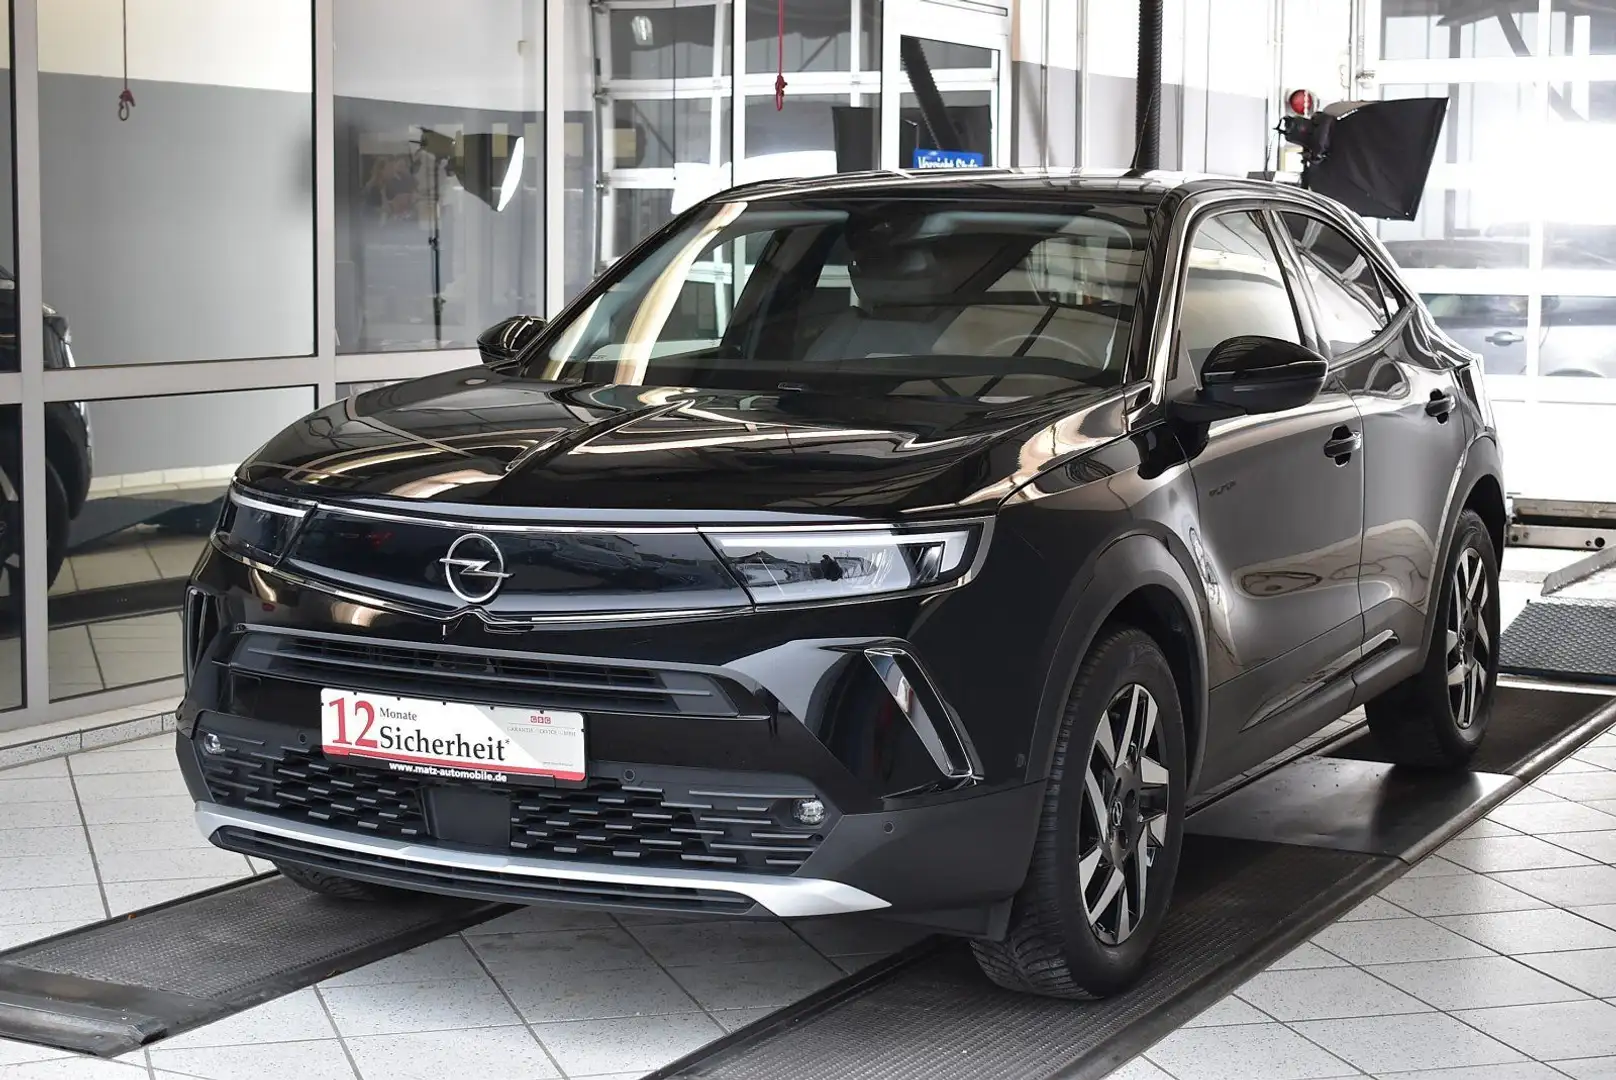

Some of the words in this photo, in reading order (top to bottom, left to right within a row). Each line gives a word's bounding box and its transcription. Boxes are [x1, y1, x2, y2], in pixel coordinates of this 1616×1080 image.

[328, 697, 378, 749] 12
[379, 707, 418, 722] Monate
[388, 762, 508, 783] www.matz-automobile.de
